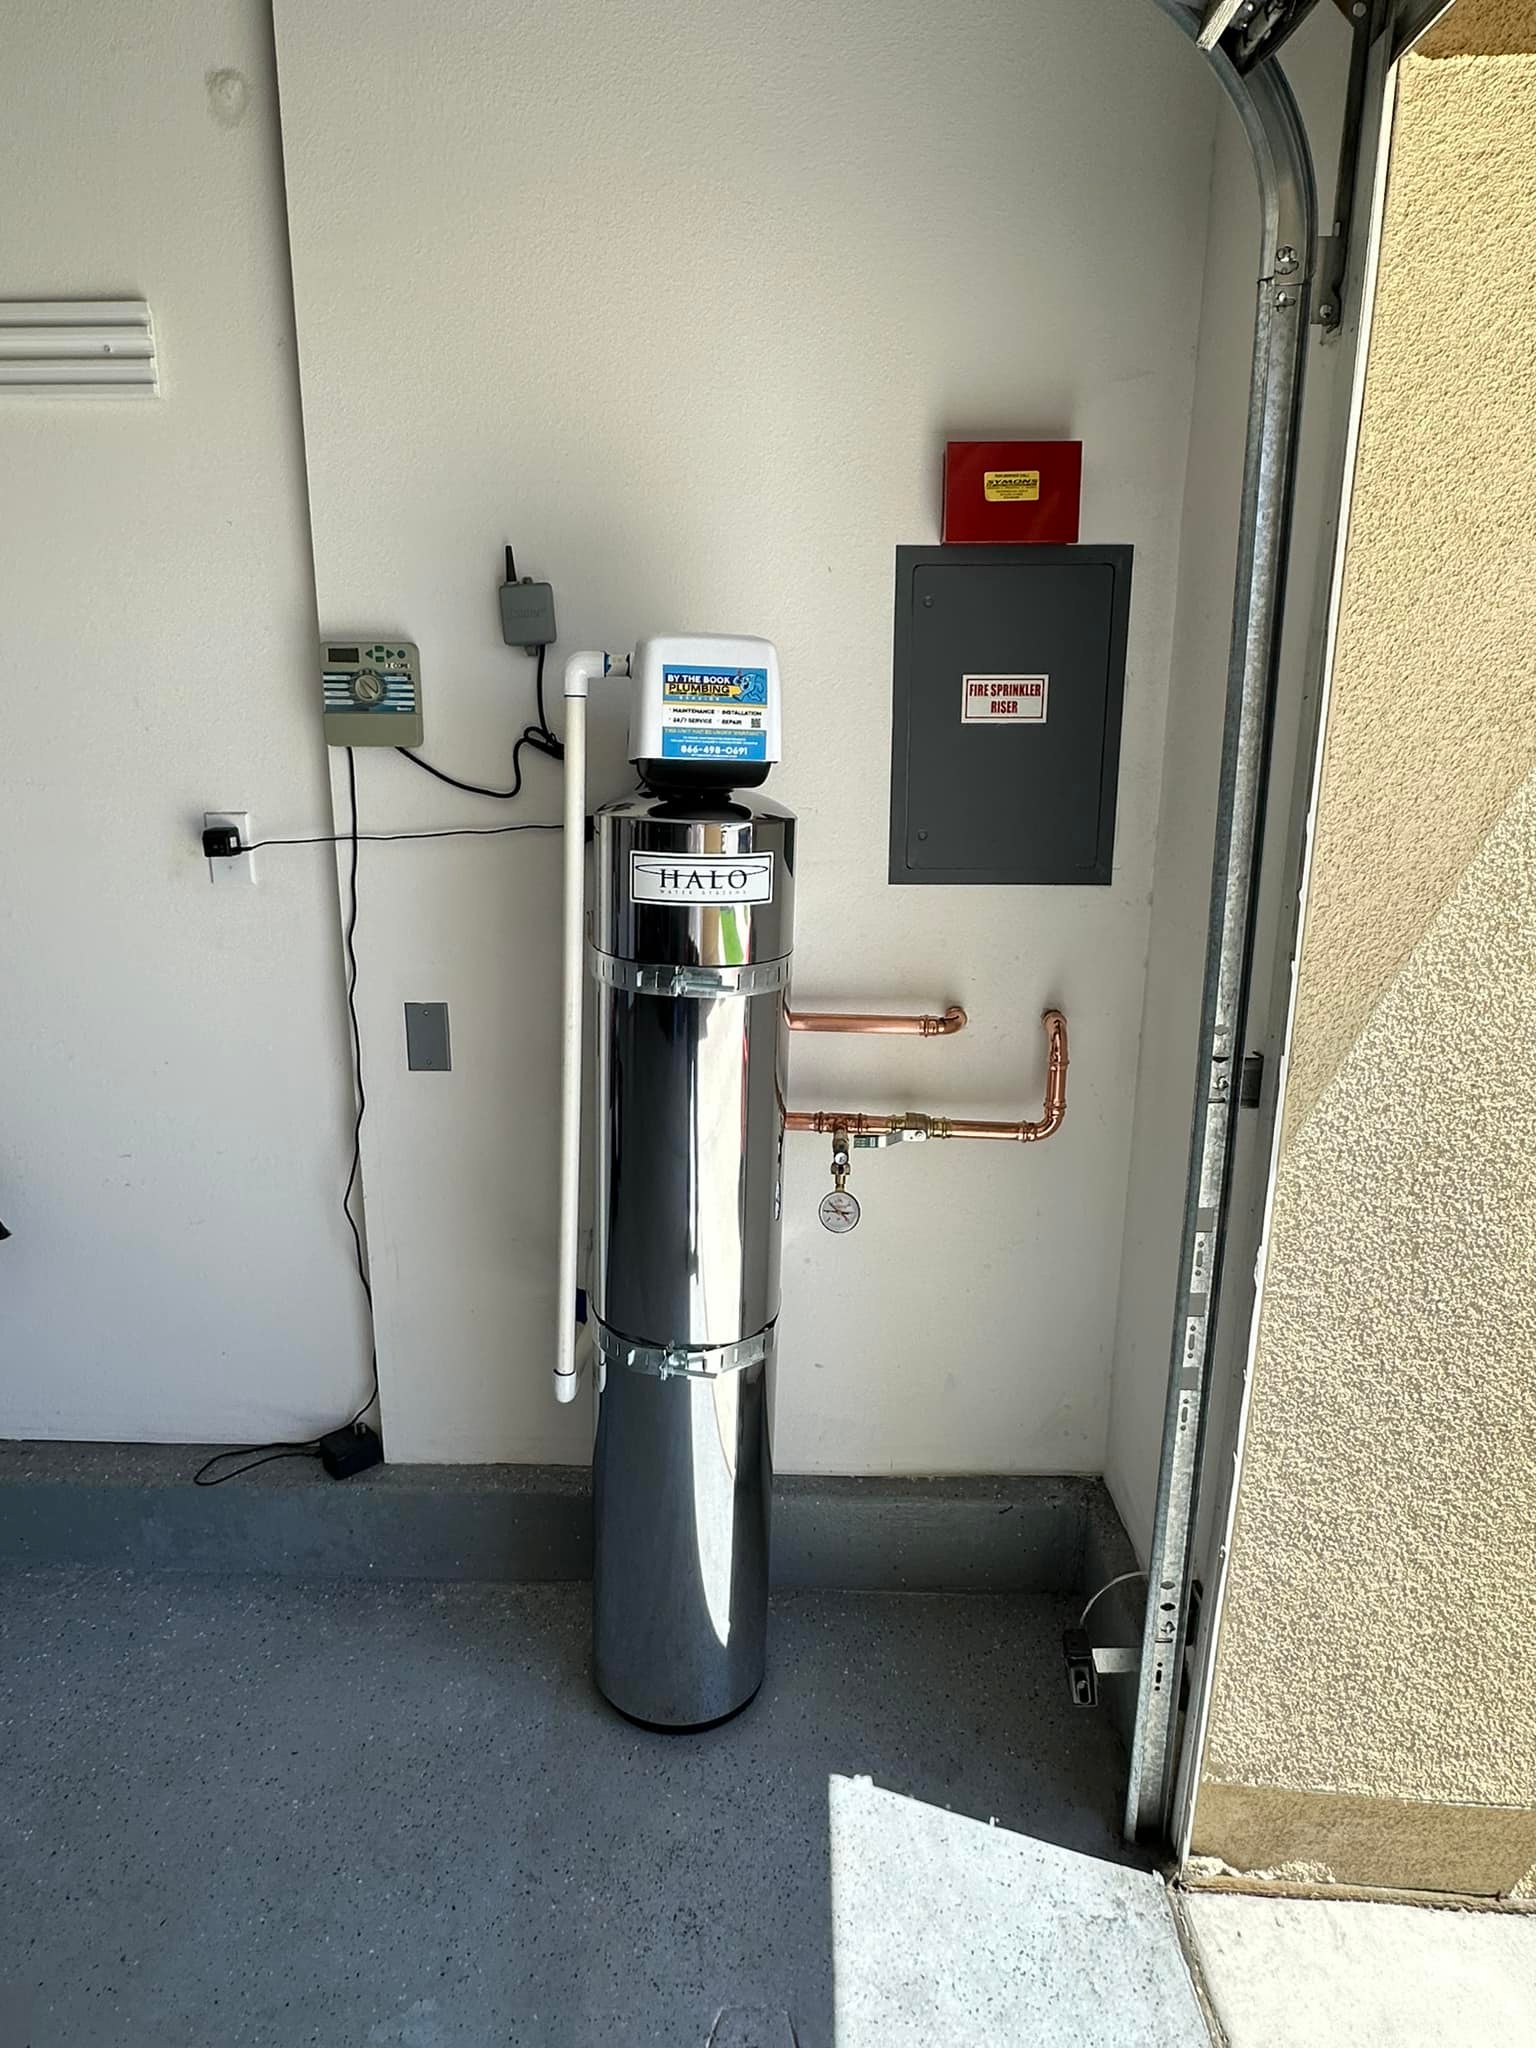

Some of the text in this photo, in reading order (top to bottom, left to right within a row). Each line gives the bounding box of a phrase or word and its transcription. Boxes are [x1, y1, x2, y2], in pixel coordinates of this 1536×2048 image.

[667, 674, 731, 684] BY THE BOOK
[669, 684, 730, 693] PLUMBING
[969, 684, 1041, 696] FIRE SPRINKLER
[991, 701, 1018, 713] RISER
[681, 745, 748, 755] 866-498-0691
[659, 869, 748, 889] HALO
